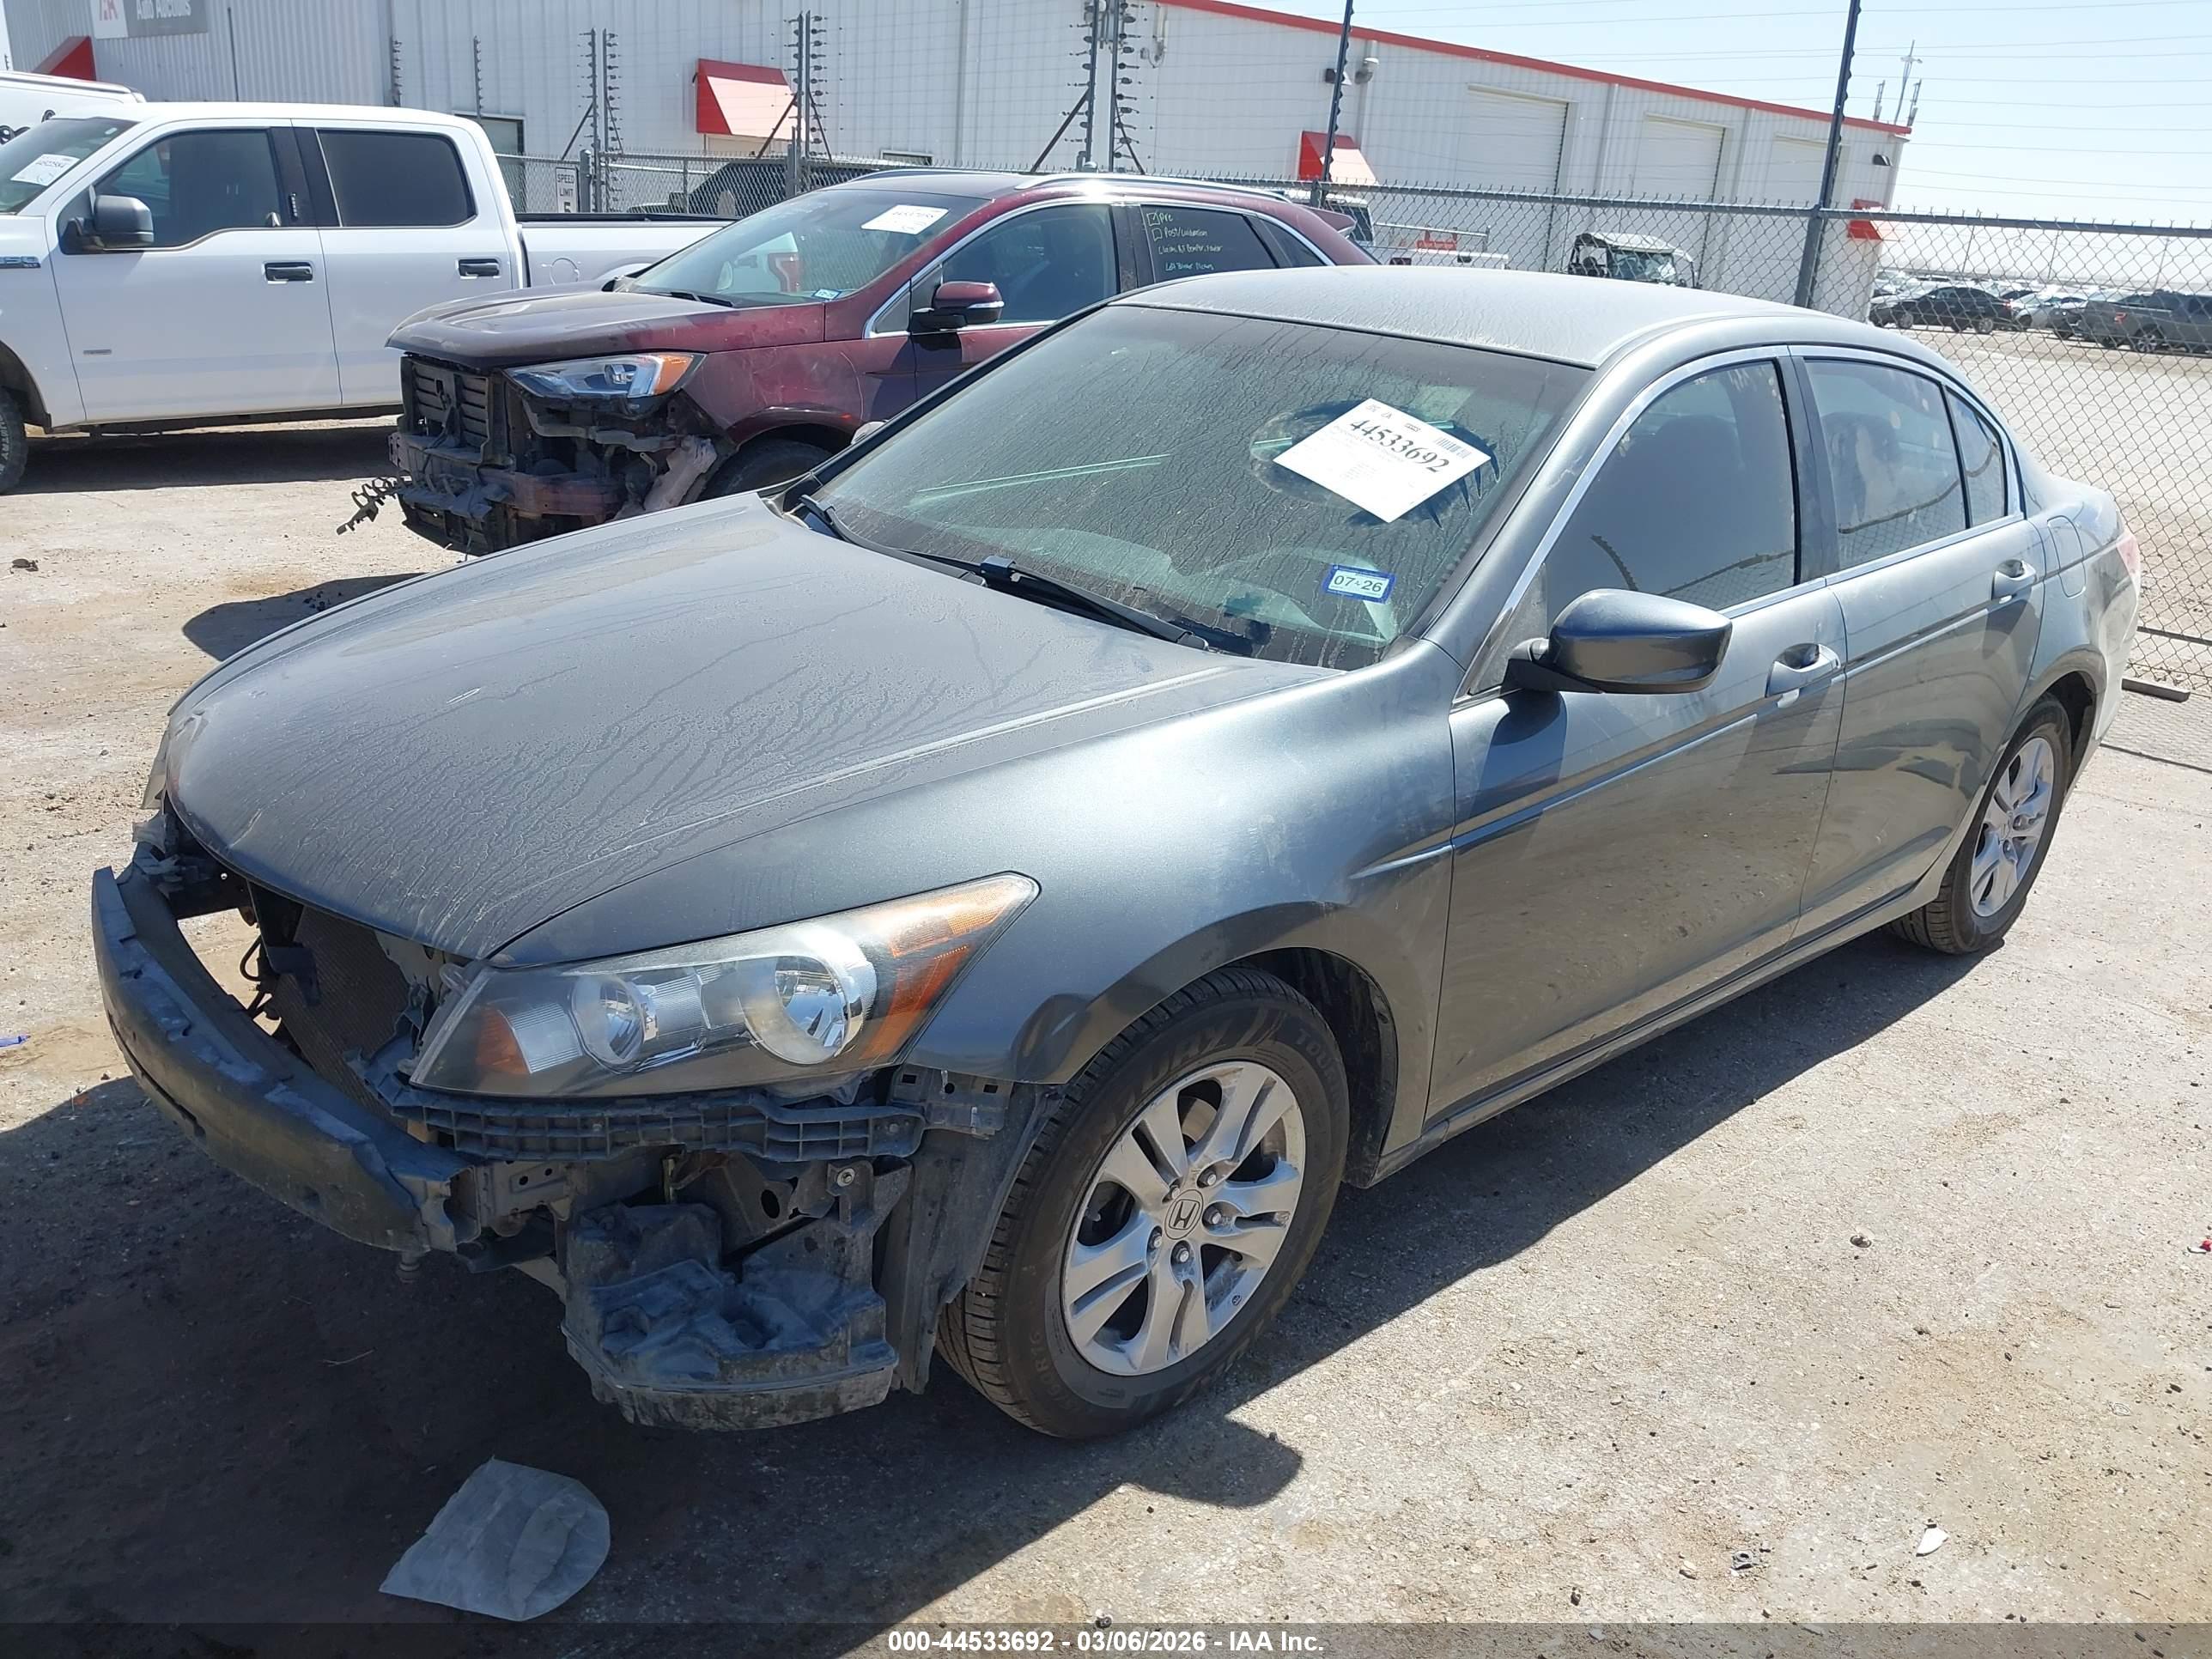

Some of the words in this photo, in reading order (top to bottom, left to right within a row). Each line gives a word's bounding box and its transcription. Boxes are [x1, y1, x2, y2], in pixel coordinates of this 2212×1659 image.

[557, 173, 574, 184] SPEED
[560, 188, 574, 197] LIMIT
[1350, 419, 1449, 473] 44533692
